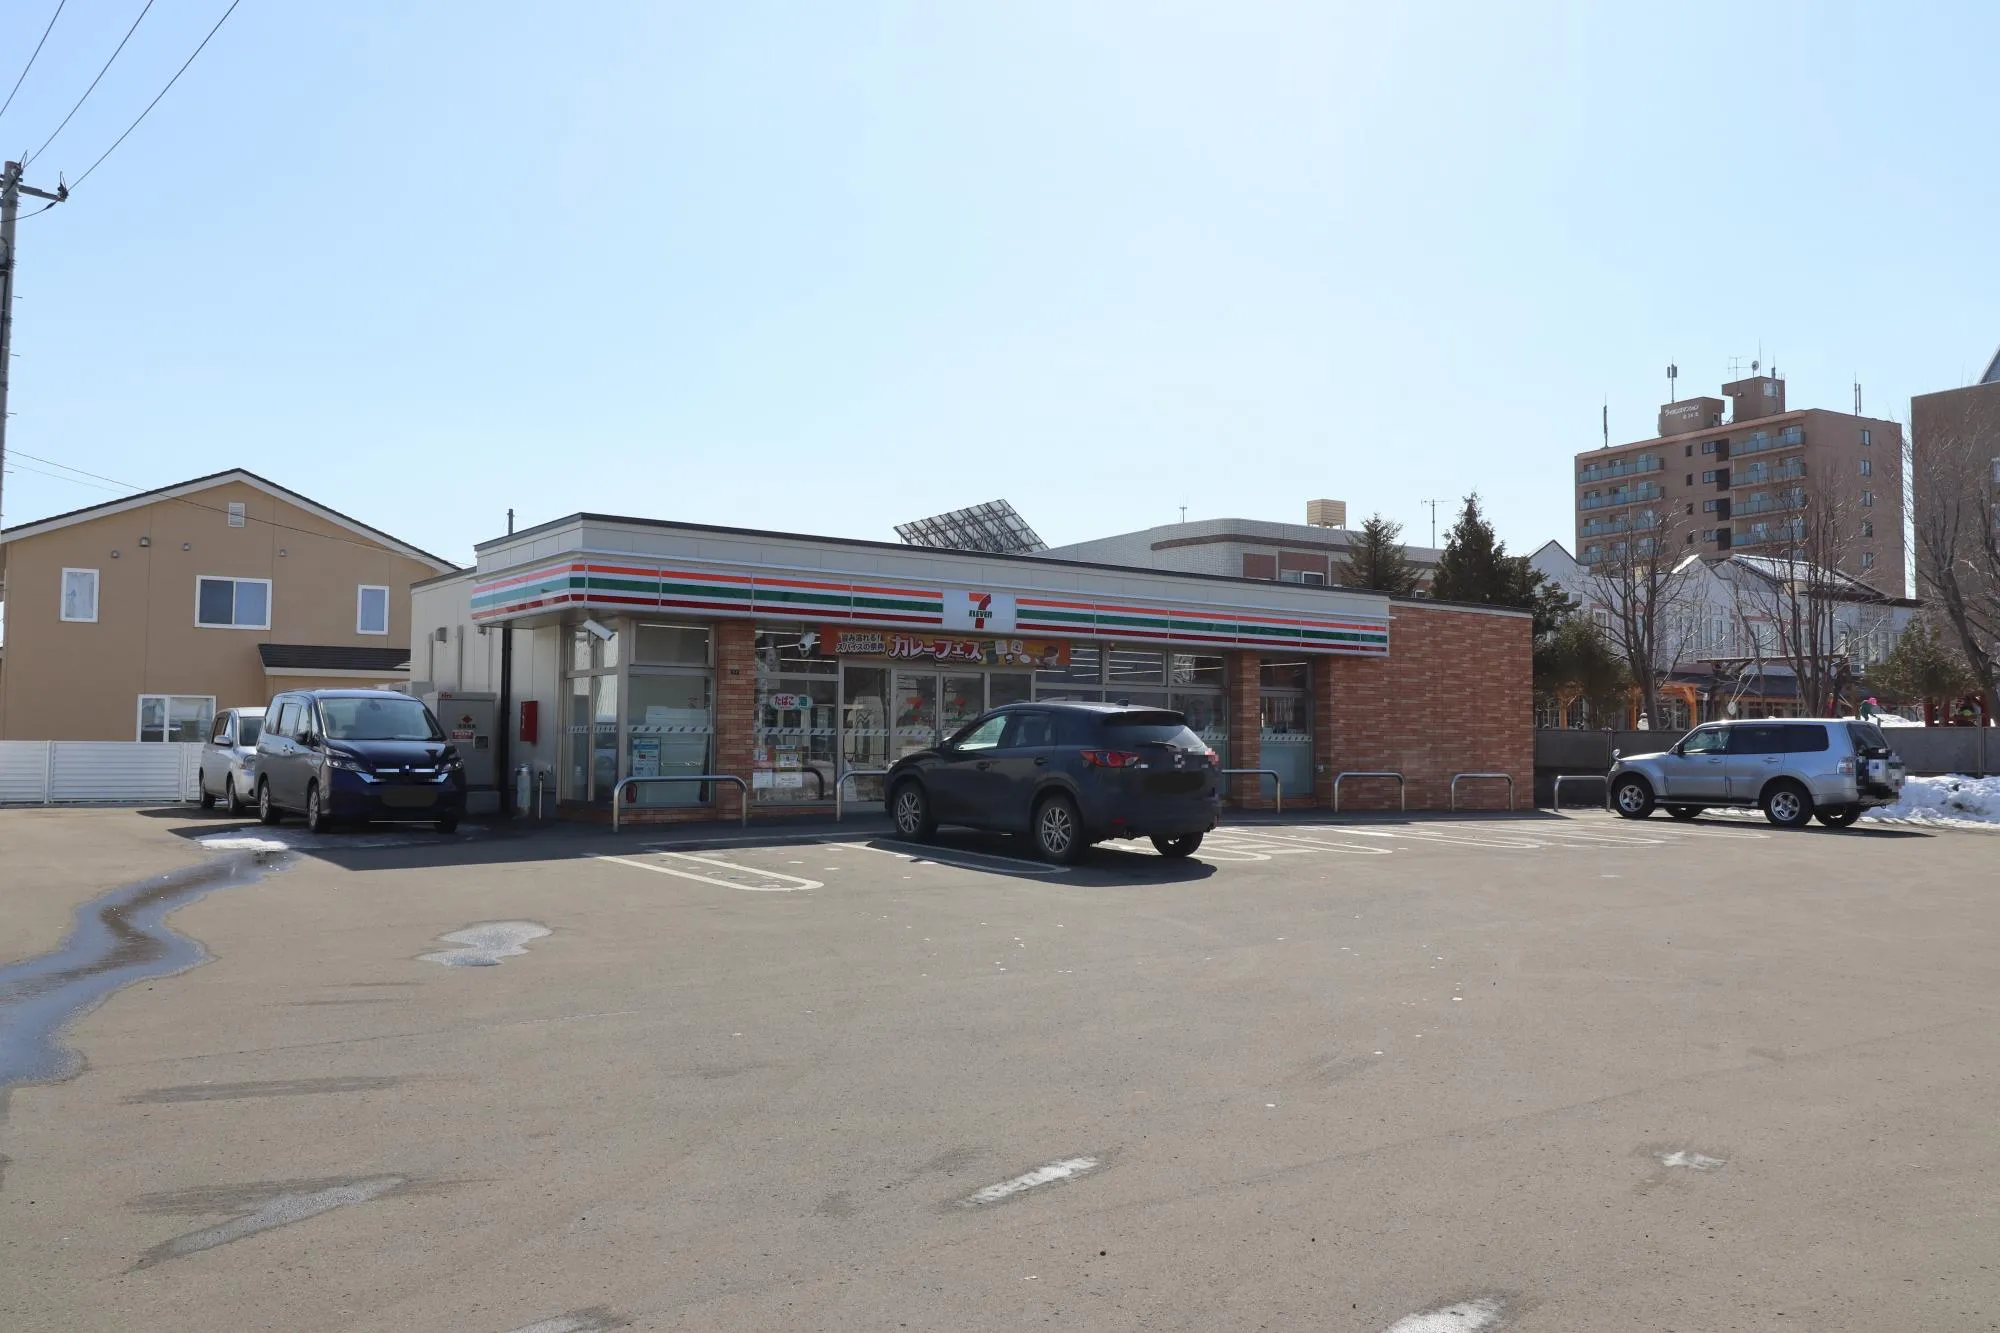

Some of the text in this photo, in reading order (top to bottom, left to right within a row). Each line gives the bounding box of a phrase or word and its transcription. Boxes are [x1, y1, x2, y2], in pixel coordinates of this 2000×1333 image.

[968, 592, 992, 628] 7
[888, 634, 983, 661] カレーフェス
[774, 695, 795, 706] たばこ
[799, 696, 808, 707] 酒
